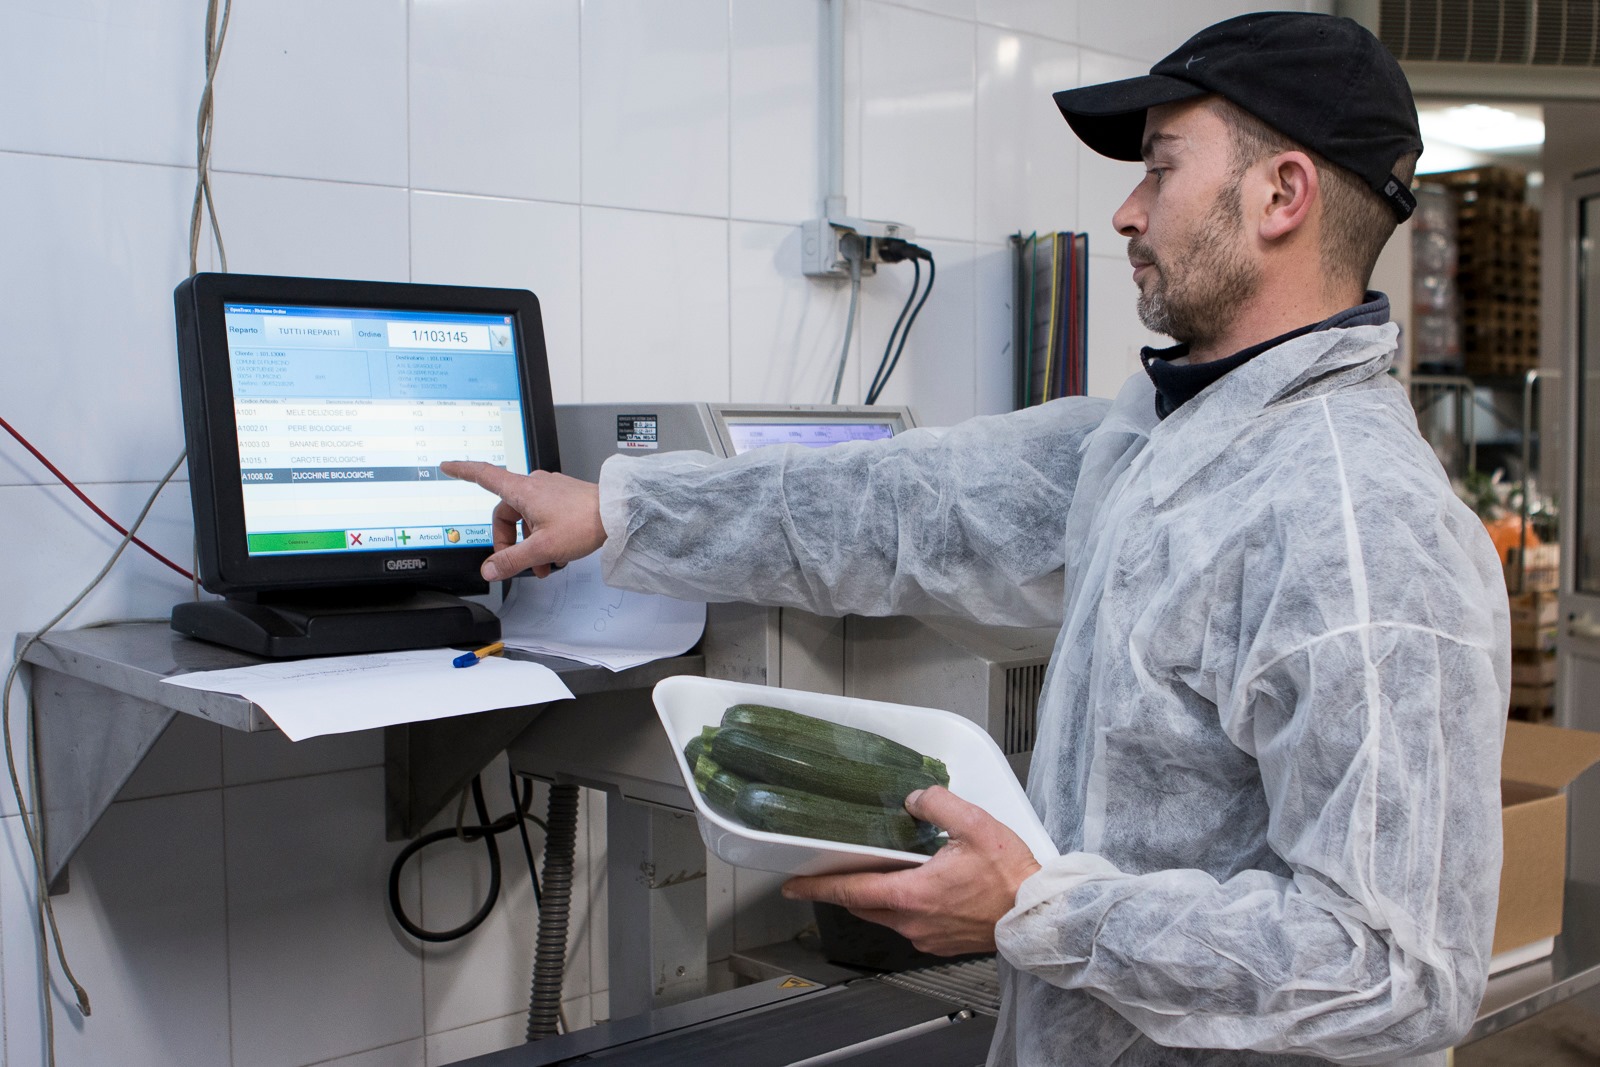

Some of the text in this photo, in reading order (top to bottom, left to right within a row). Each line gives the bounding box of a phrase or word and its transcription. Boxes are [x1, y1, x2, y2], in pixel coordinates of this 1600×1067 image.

[229, 326, 258, 335] Reparto
[358, 330, 381, 338] Ordine
[412, 330, 468, 343] 1/103145
[307, 409, 344, 417] DELIZIOSE
[331, 471, 374, 479] BIOLOGICHE
[419, 470, 430, 478] KG
[465, 528, 486, 536] Chiudi
[369, 534, 393, 542] Annulla
